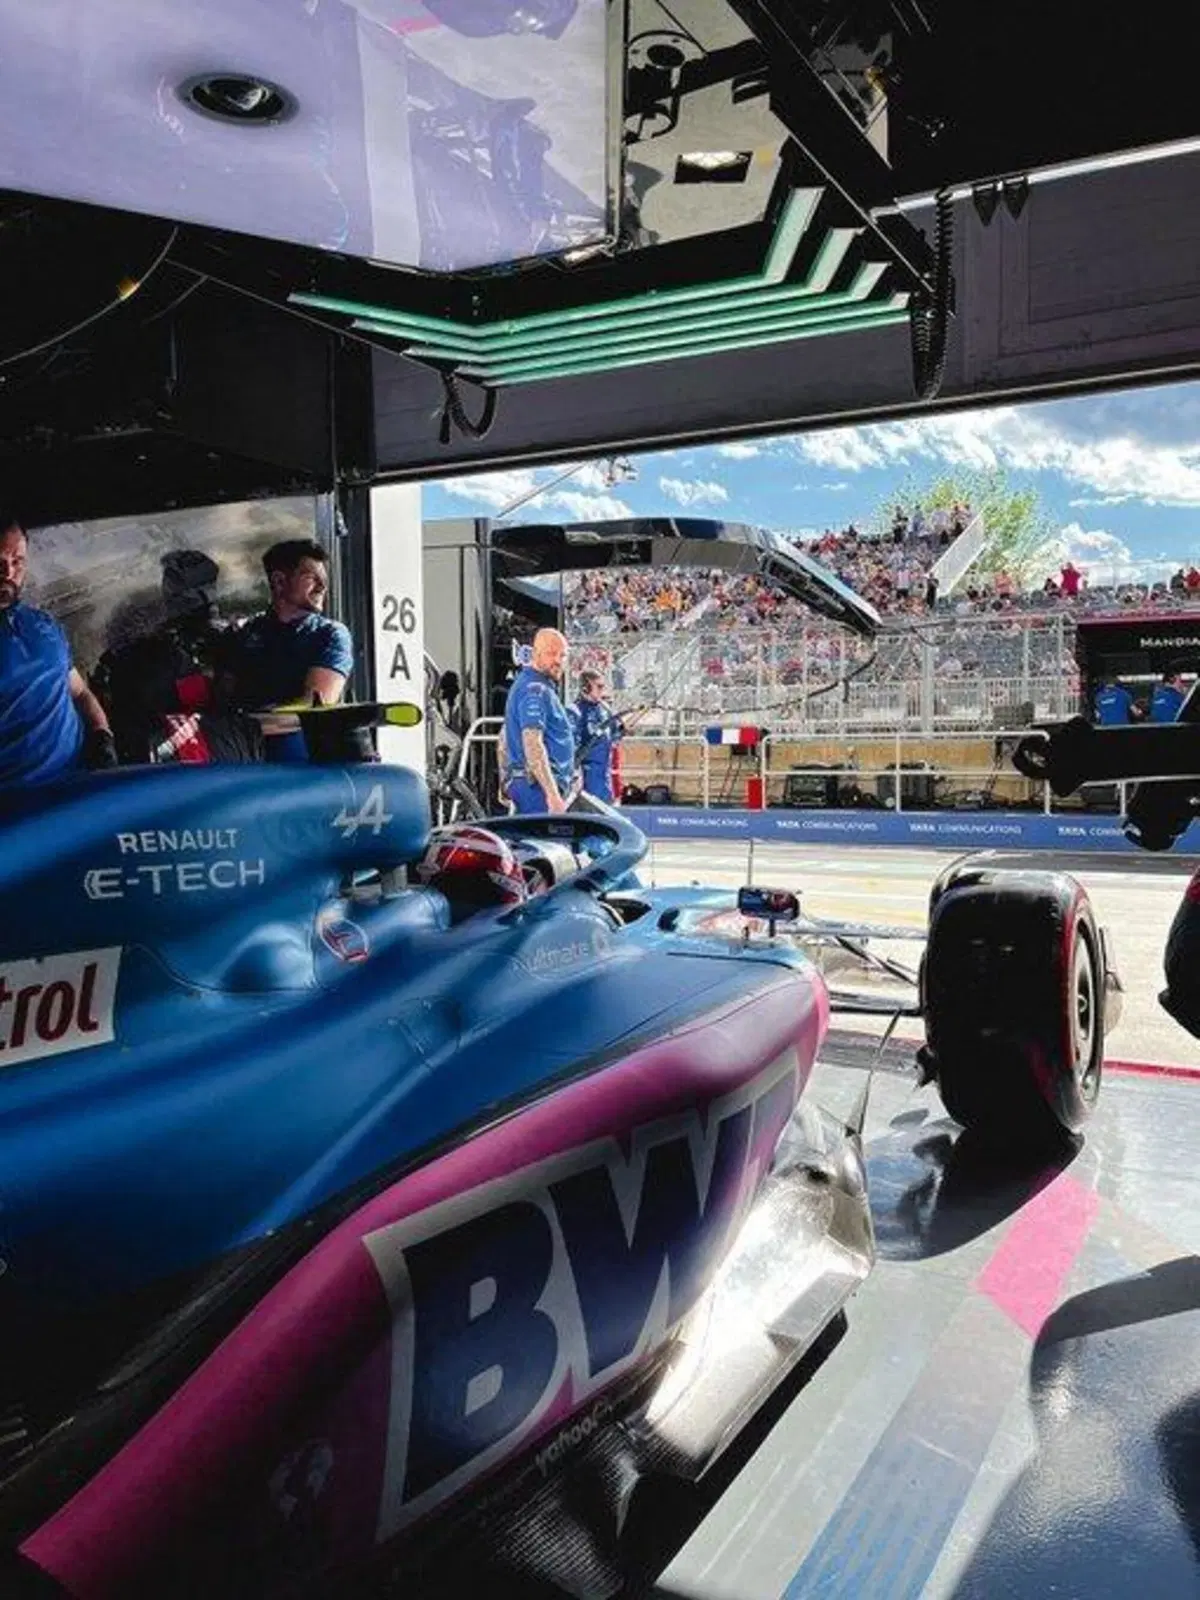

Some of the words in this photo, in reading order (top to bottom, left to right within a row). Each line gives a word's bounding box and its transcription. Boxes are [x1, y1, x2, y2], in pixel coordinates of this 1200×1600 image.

[382, 594, 416, 634] 26
[389, 642, 411, 680] A
[657, 817, 678, 826] TATA
[680, 817, 749, 828] COMMUNICATIONS
[776, 820, 801, 829] TATA
[802, 820, 879, 832] COMMUNICATIONS
[909, 823, 935, 832] TATA
[937, 823, 1022, 835] COMMUNICATIONS
[1057, 826, 1086, 837] TATA
[116, 828, 240, 855] RENAULT
[84, 857, 266, 901] E-TECH
